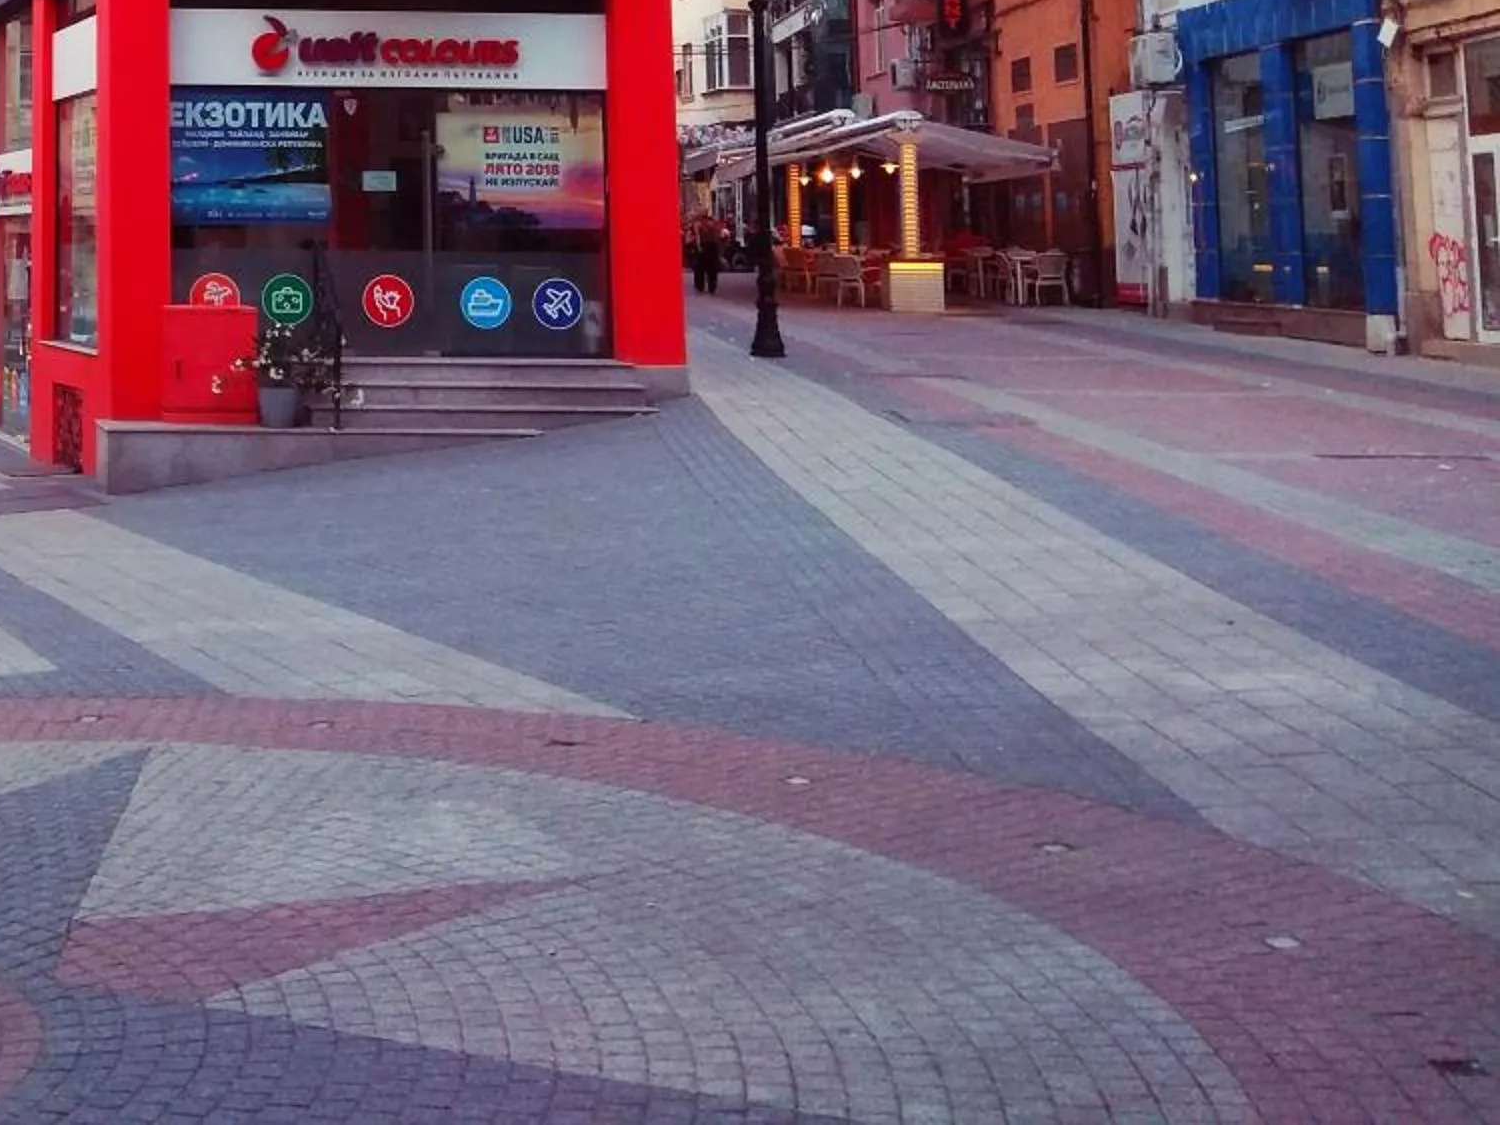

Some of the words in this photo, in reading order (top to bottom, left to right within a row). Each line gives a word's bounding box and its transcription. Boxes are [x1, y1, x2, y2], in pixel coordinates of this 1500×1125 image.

[170, 100, 328, 129] ЕКЗОТИКА
[513, 125, 545, 144] USA
[484, 163, 523, 175] ЛЯТО
[525, 163, 560, 176] 2018
